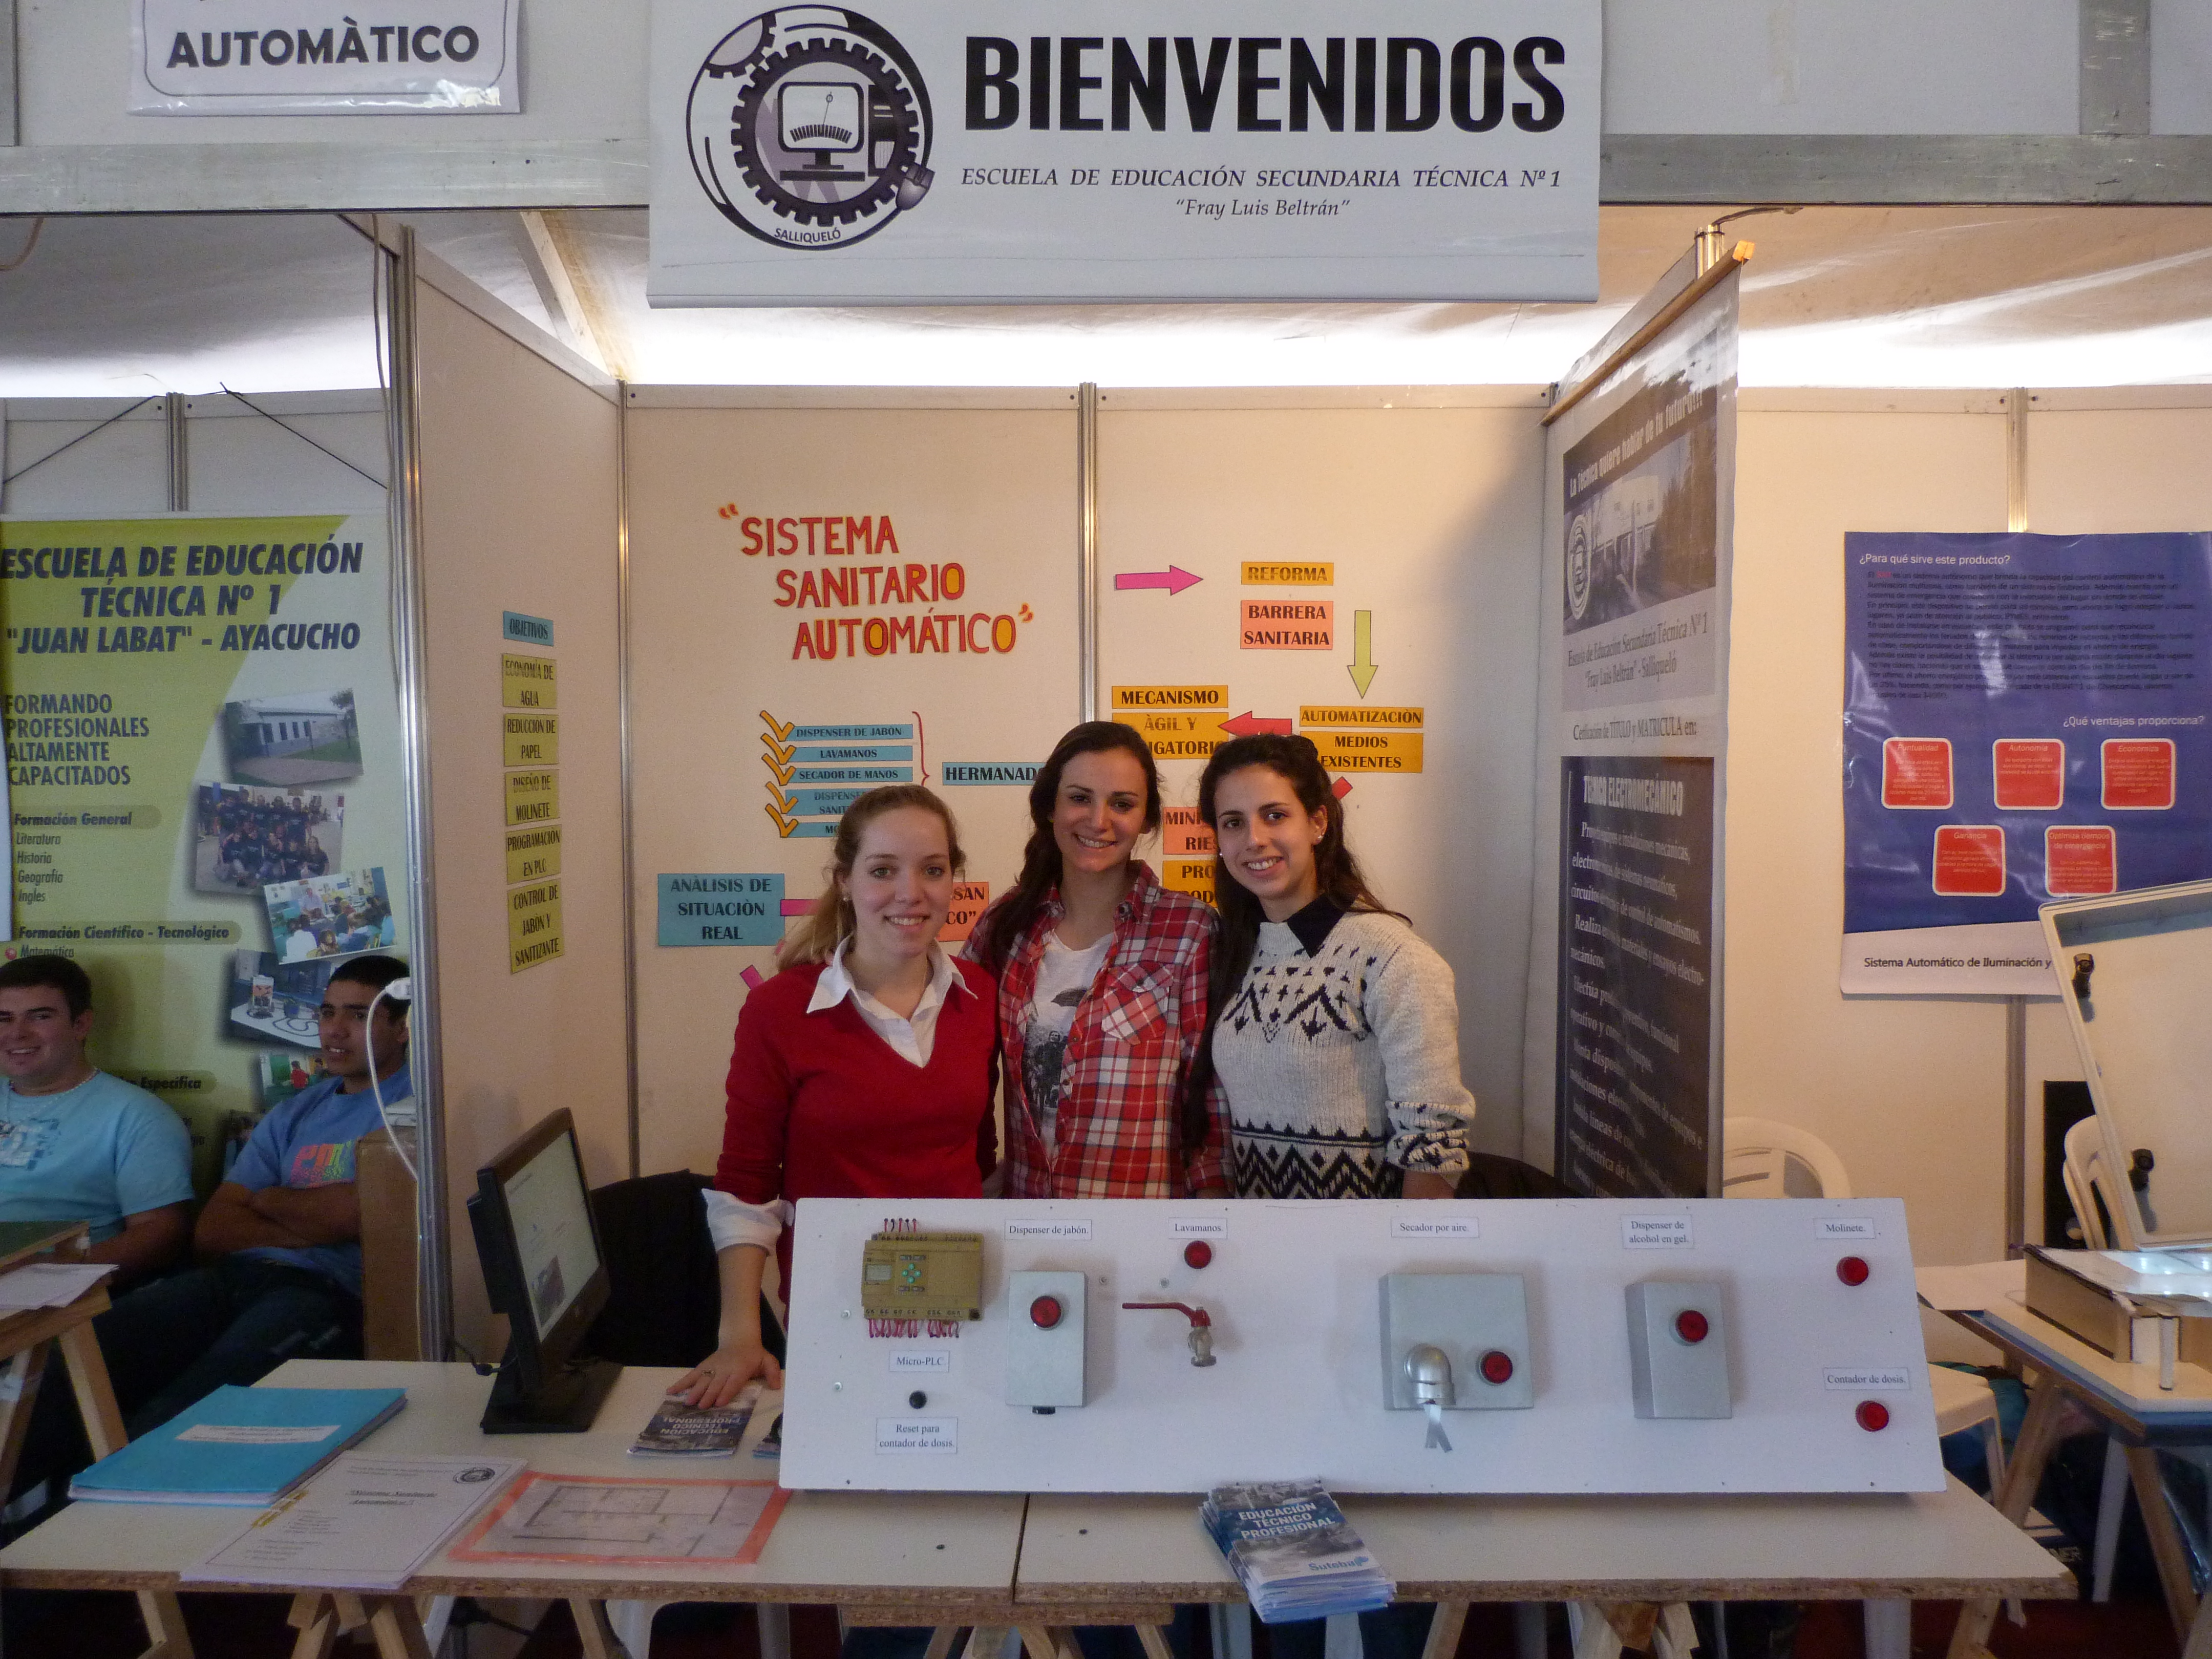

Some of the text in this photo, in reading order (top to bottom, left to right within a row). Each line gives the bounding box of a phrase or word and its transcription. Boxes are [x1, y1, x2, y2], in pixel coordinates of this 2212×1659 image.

[965, 36, 1565, 133] BIENVENIDOS
[961, 168, 1058, 186] ESCUELA
[1070, 168, 1099, 186] DE
[1110, 165, 1246, 187] EDUCACIÓN
[1256, 169, 1401, 188] SECUNDARIA
[1413, 165, 1509, 188] TÉCNICA
[1231, 199, 1269, 217] Luis
[774, 227, 841, 243] SALLIQUELÓ
[0, 534, 364, 579] ESCUELA DE EDUCACIÓN
[1859, 554, 2011, 566] ¿Para qué sirve este producto?
[1248, 566, 1328, 582] REFORMA
[774, 562, 965, 609] SANITARIO
[80, 578, 206, 618] TÉCNICA
[269, 584, 282, 615] 1
[1248, 605, 1326, 620] BARRERA
[509, 618, 548, 640] OBJETIVOS
[219, 622, 361, 652] AYACUCHO
[1244, 630, 1330, 645] SANITARIA
[543, 665, 554, 680] DE
[4, 694, 112, 714] FORMANDO
[520, 690, 539, 706] AGUA
[1121, 690, 1219, 705] MECANISMO
[5, 717, 150, 738] PROFESIONALES
[546, 719, 556, 734] DE
[1186, 717, 1197, 731] Y
[2063, 715, 2205, 728] ¿Qué ventajas proporciona?
[796, 728, 851, 738] DISPENSER
[854, 727, 867, 737] DE
[1334, 735, 1389, 749] MEDIOS
[9, 741, 110, 761] ALTAMENTE
[521, 745, 542, 759] PAPEL
[820, 749, 877, 759] LAVAMANOS
[1320, 755, 1402, 768] EXISTENTES
[9, 765, 131, 785] CAPACITADOS
[799, 770, 898, 780] SECADOR DE MANOS
[946, 767, 1038, 780] HERMANAD
[541, 775, 551, 790] DE
[81, 812, 132, 825] General
[516, 802, 550, 821] MOLINETE
[16, 832, 61, 845] Literatura
[17, 851, 52, 864] Historia
[523, 858, 547, 877] EN PLC
[750, 879, 772, 892] DE
[514, 884, 559, 910] CONTROL DE
[546, 913, 551, 929] Y
[701, 926, 743, 940] REAL
[515, 937, 560, 967] SANITIZANTE
[1864, 956, 2052, 971] Sistema Automático de Iluminación y
[1009, 1225, 1089, 1235] Dispenser de jabón.
[1399, 1222, 1433, 1232] Secador
[1435, 1224, 1450, 1235] por
[1631, 1221, 1685, 1231] Dispenser de
[1825, 1224, 1866, 1232] Molinete.
[1629, 1235, 1660, 1243] alcohol
[1673, 1235, 1689, 1245] gel.
[1827, 1374, 1906, 1384] Contador de dosis.
[896, 1424, 940, 1434] Reset para
[879, 1439, 917, 1448] contador
[919, 1439, 929, 1447] de
[1238, 1502, 1317, 1521] EDUCACIÓN
[1240, 1516, 1335, 1540] PROFESIONAL
